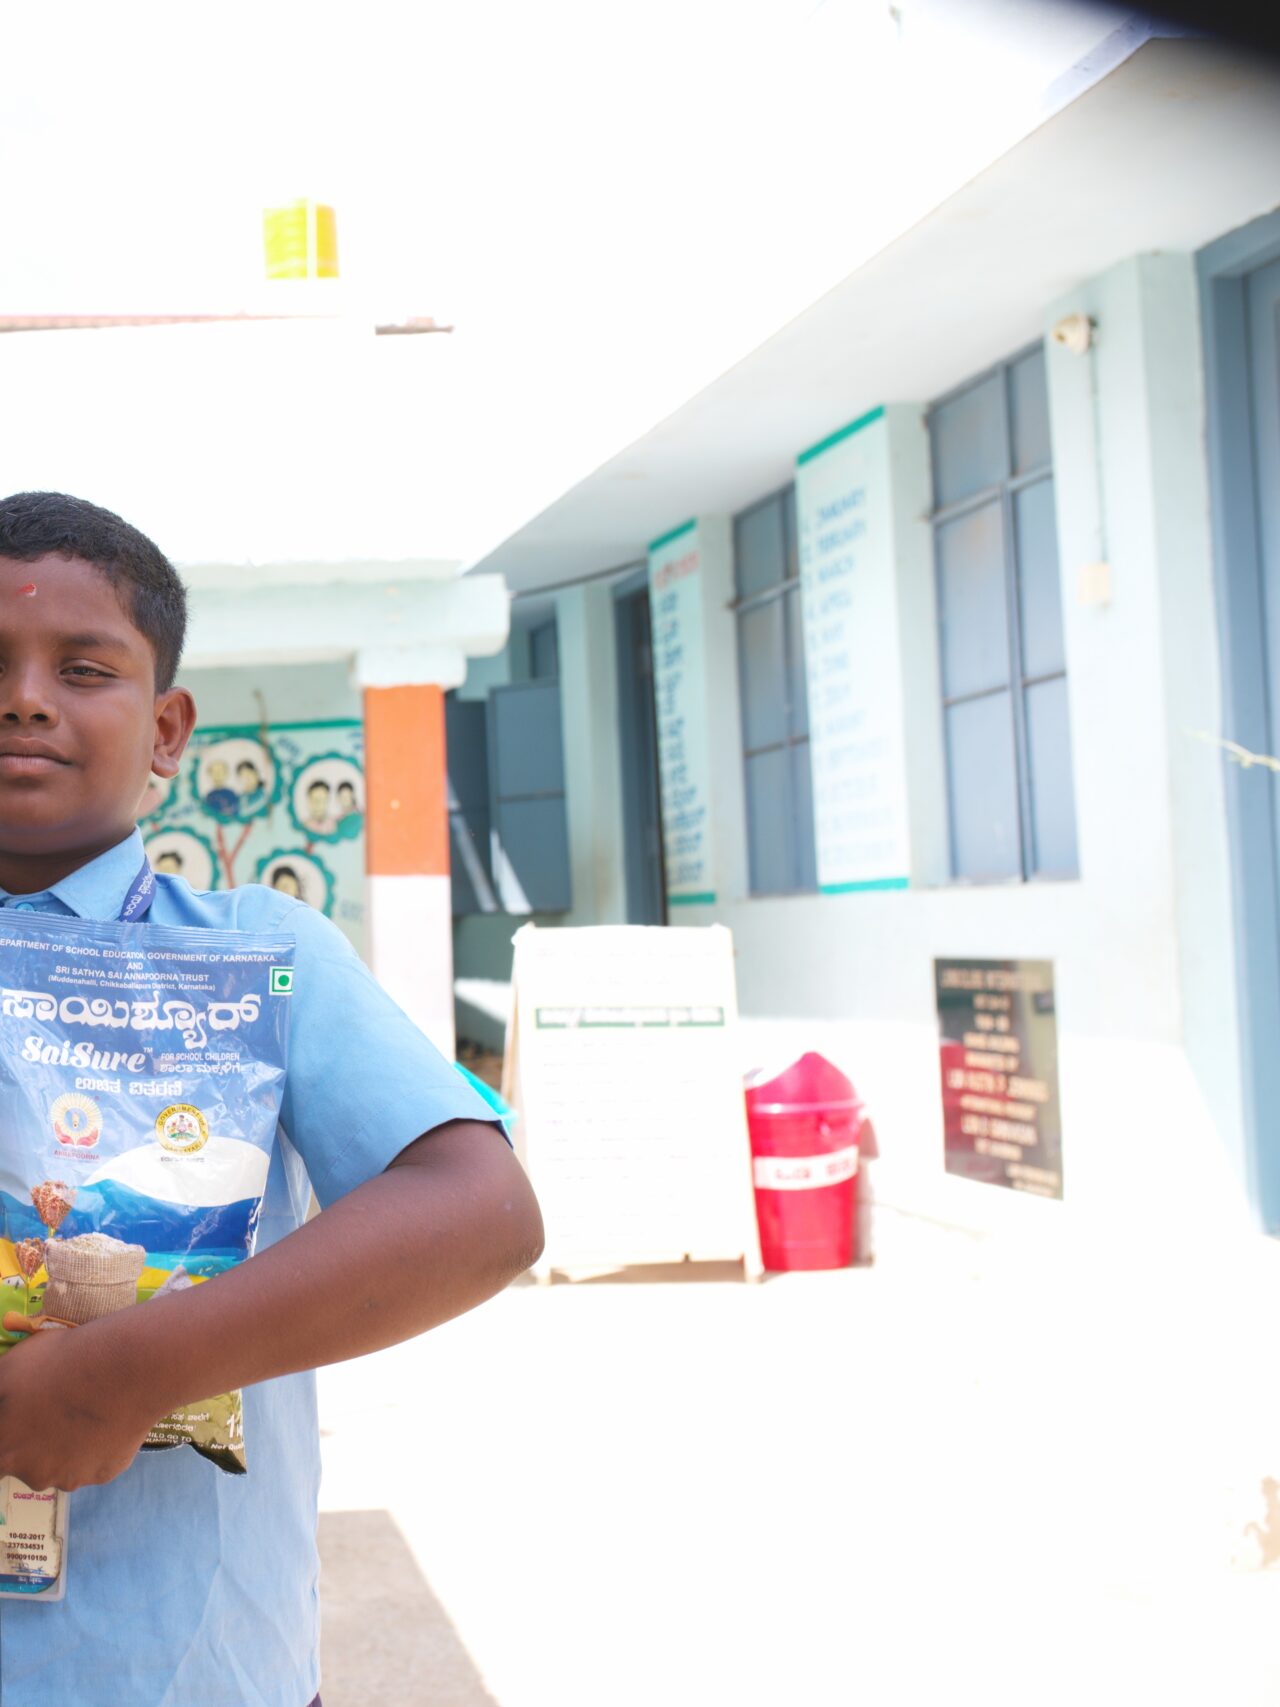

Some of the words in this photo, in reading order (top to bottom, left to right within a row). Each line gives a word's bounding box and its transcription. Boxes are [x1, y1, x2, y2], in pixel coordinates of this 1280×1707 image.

[51, 944, 64, 952] OF
[65, 945, 101, 957] SCHOOL
[147, 952, 207, 962] GOVERNMENT
[209, 954, 221, 962] OF
[126, 962, 144, 971] AND
[55, 965, 71, 975] SRI
[72, 967, 106, 978] SATHYA
[107, 971, 123, 979] SAI
[180, 973, 210, 982] TRUST
[1, 988, 262, 1050] ಸಾಯಿಶ್ಯೂರ್
[160, 1052, 175, 1062] FOR
[175, 1052, 204, 1062] SCHOOL
[204, 1052, 240, 1062] CHILDREN
[9, 1532, 46, 1541] 10-02-2017
